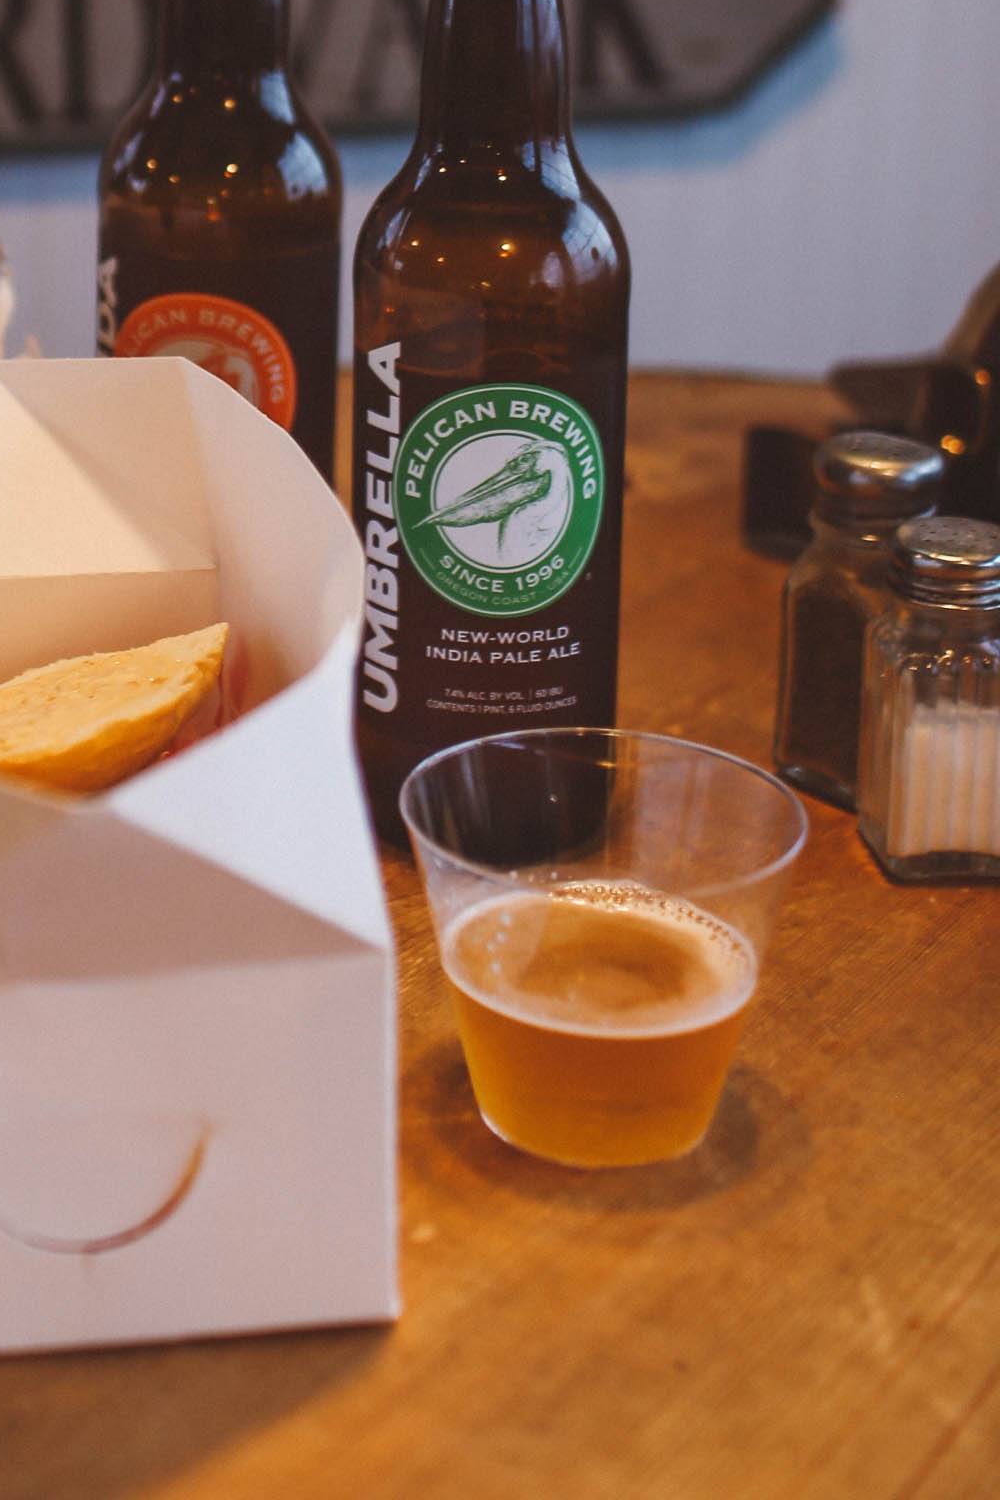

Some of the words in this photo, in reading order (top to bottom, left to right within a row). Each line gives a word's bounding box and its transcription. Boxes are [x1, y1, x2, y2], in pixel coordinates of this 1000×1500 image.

[198, 308, 286, 404] BREWING
[404, 401, 497, 498] PELICAN
[508, 400, 597, 499] BREWING
[363, 340, 401, 713] UMBRELLA
[439, 554, 505, 593] SINCE
[514, 553, 565, 591] 1996
[425, 645, 483, 663] INDIA
[489, 649, 542, 664] PALE
[547, 641, 581, 661] ALE
[441, 625, 569, 644] NEW-WORLD
